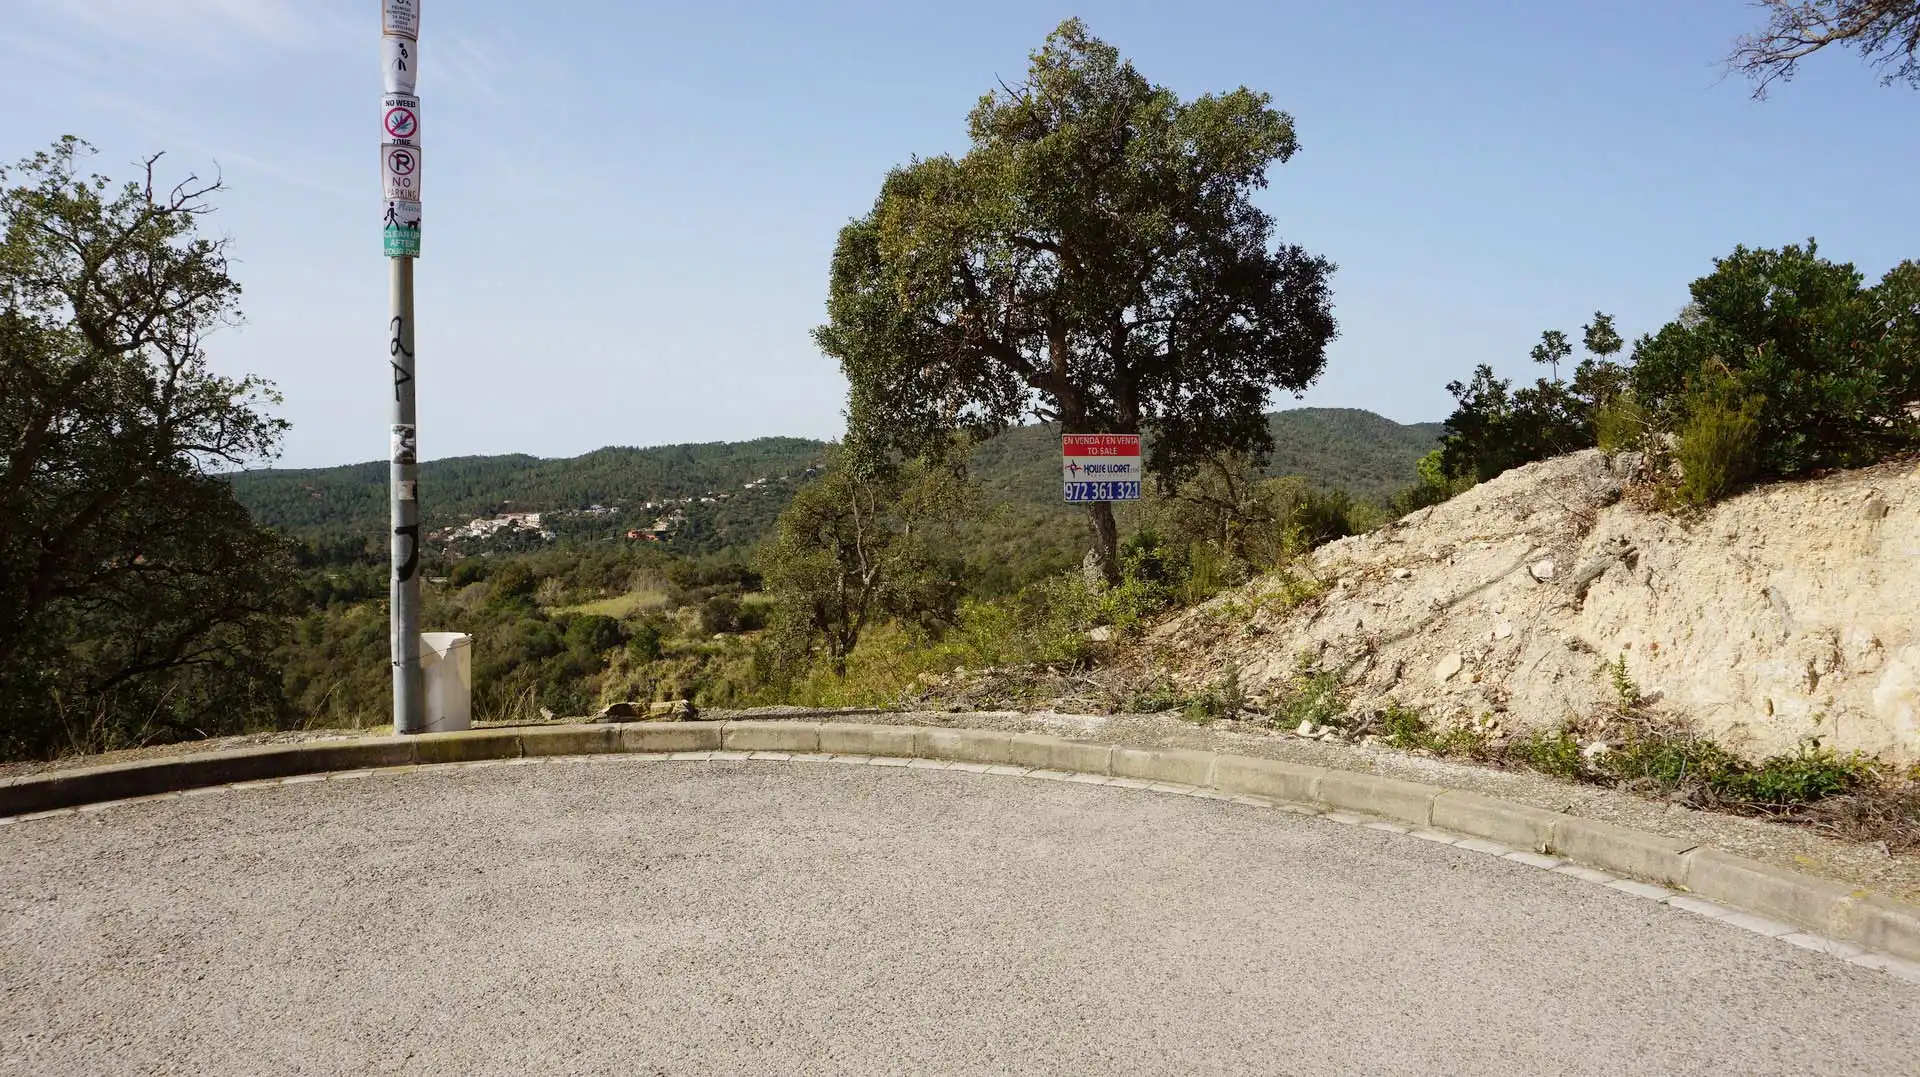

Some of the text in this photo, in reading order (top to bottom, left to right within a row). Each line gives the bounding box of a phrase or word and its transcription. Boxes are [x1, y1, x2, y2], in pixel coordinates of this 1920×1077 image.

[396, 100, 416, 108] WEED
[392, 177, 410, 188] NO
[390, 239, 415, 248] AFTER
[1064, 436, 1074, 444] EN
[1074, 436, 1100, 444] VENDA
[1106, 436, 1116, 444] EN
[1116, 436, 1138, 444] VENTA
[1065, 482, 1139, 500] 972 361 321
